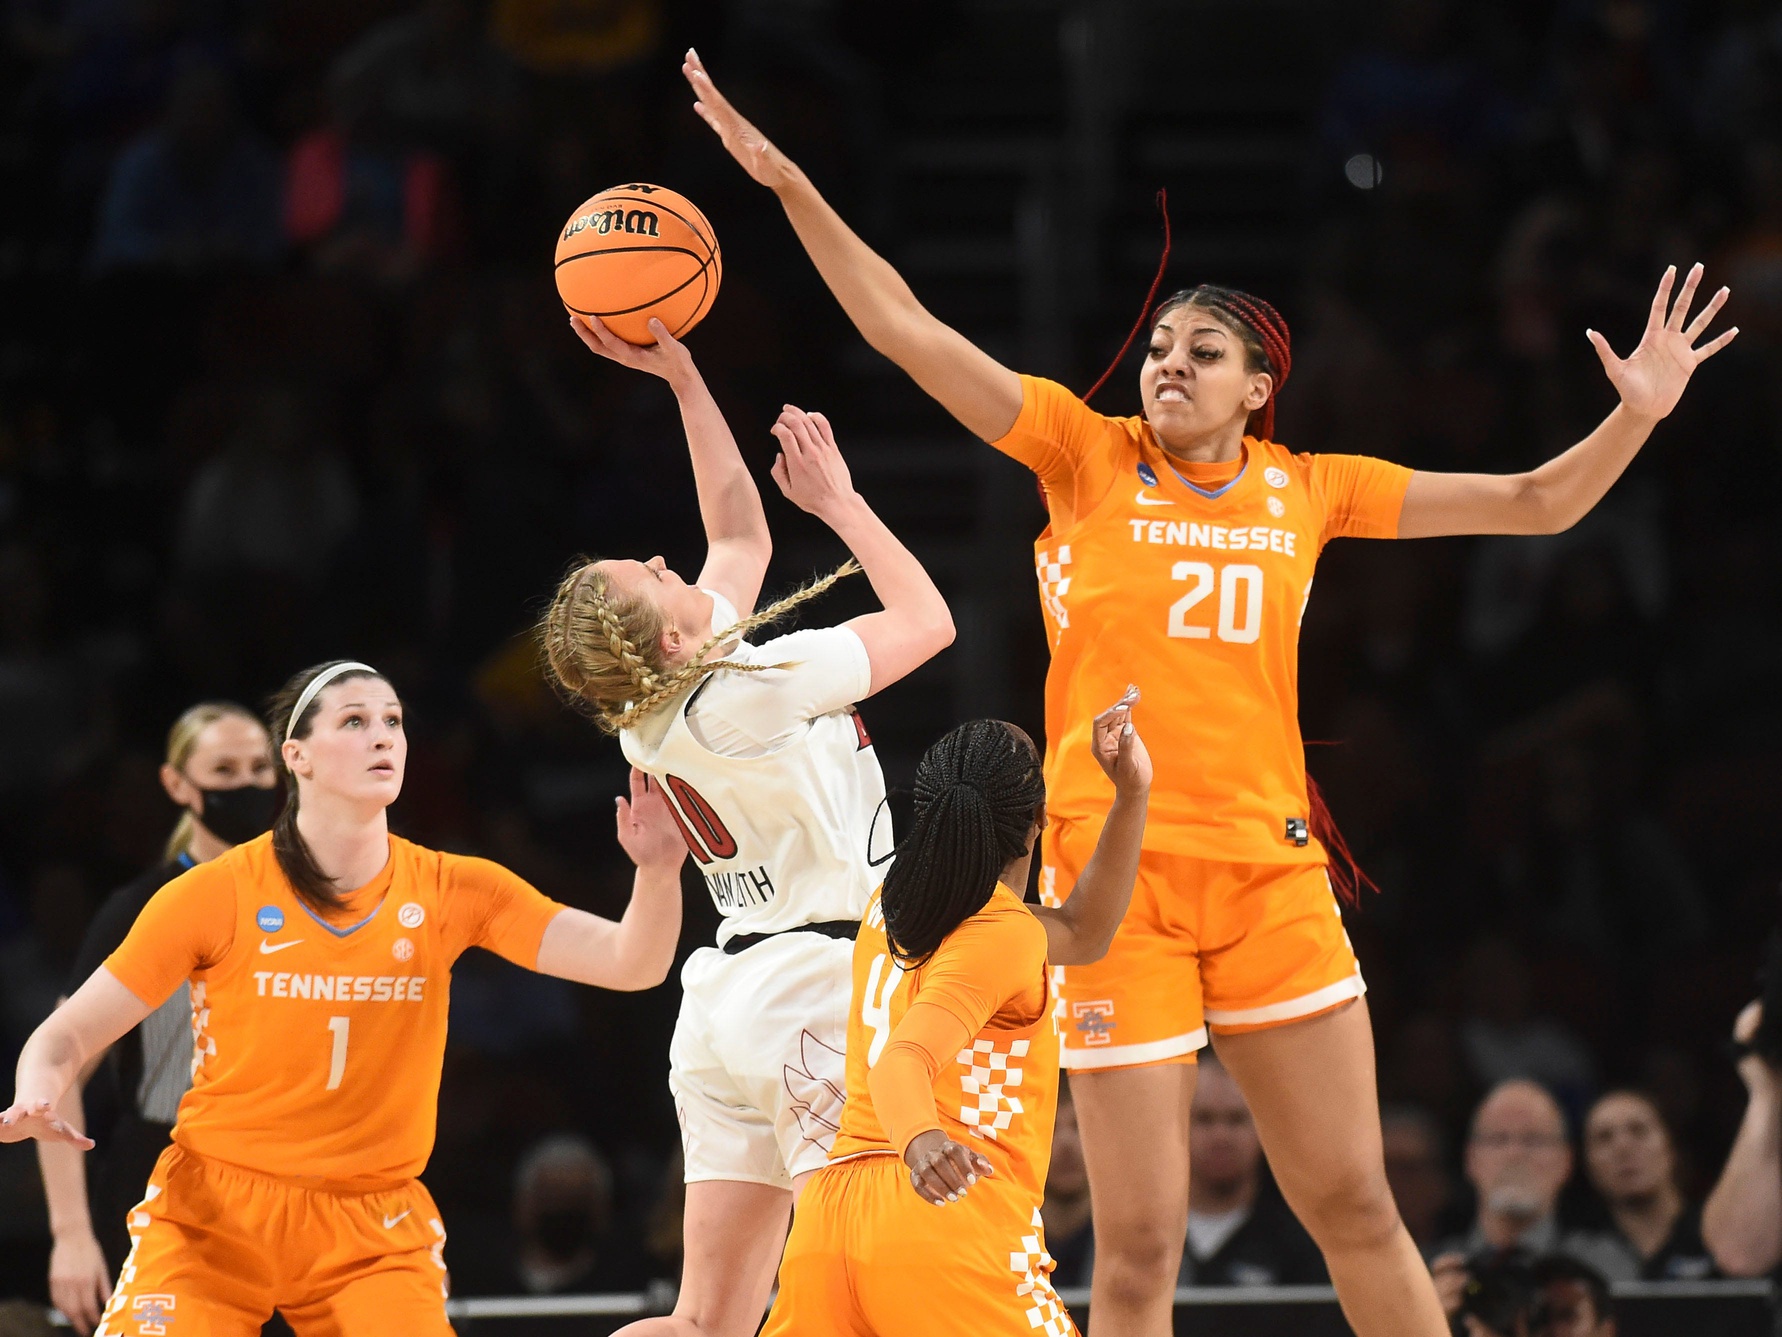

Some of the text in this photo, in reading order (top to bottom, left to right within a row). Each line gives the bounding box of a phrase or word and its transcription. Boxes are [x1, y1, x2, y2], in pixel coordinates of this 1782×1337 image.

[563, 208, 661, 241] Wilson
[1129, 519, 1297, 557] TENNESSEE
[1167, 561, 1264, 644] 20
[253, 971, 428, 1002] TENNESSEE
[862, 953, 906, 1069] 4
[326, 1016, 350, 1091] 1
